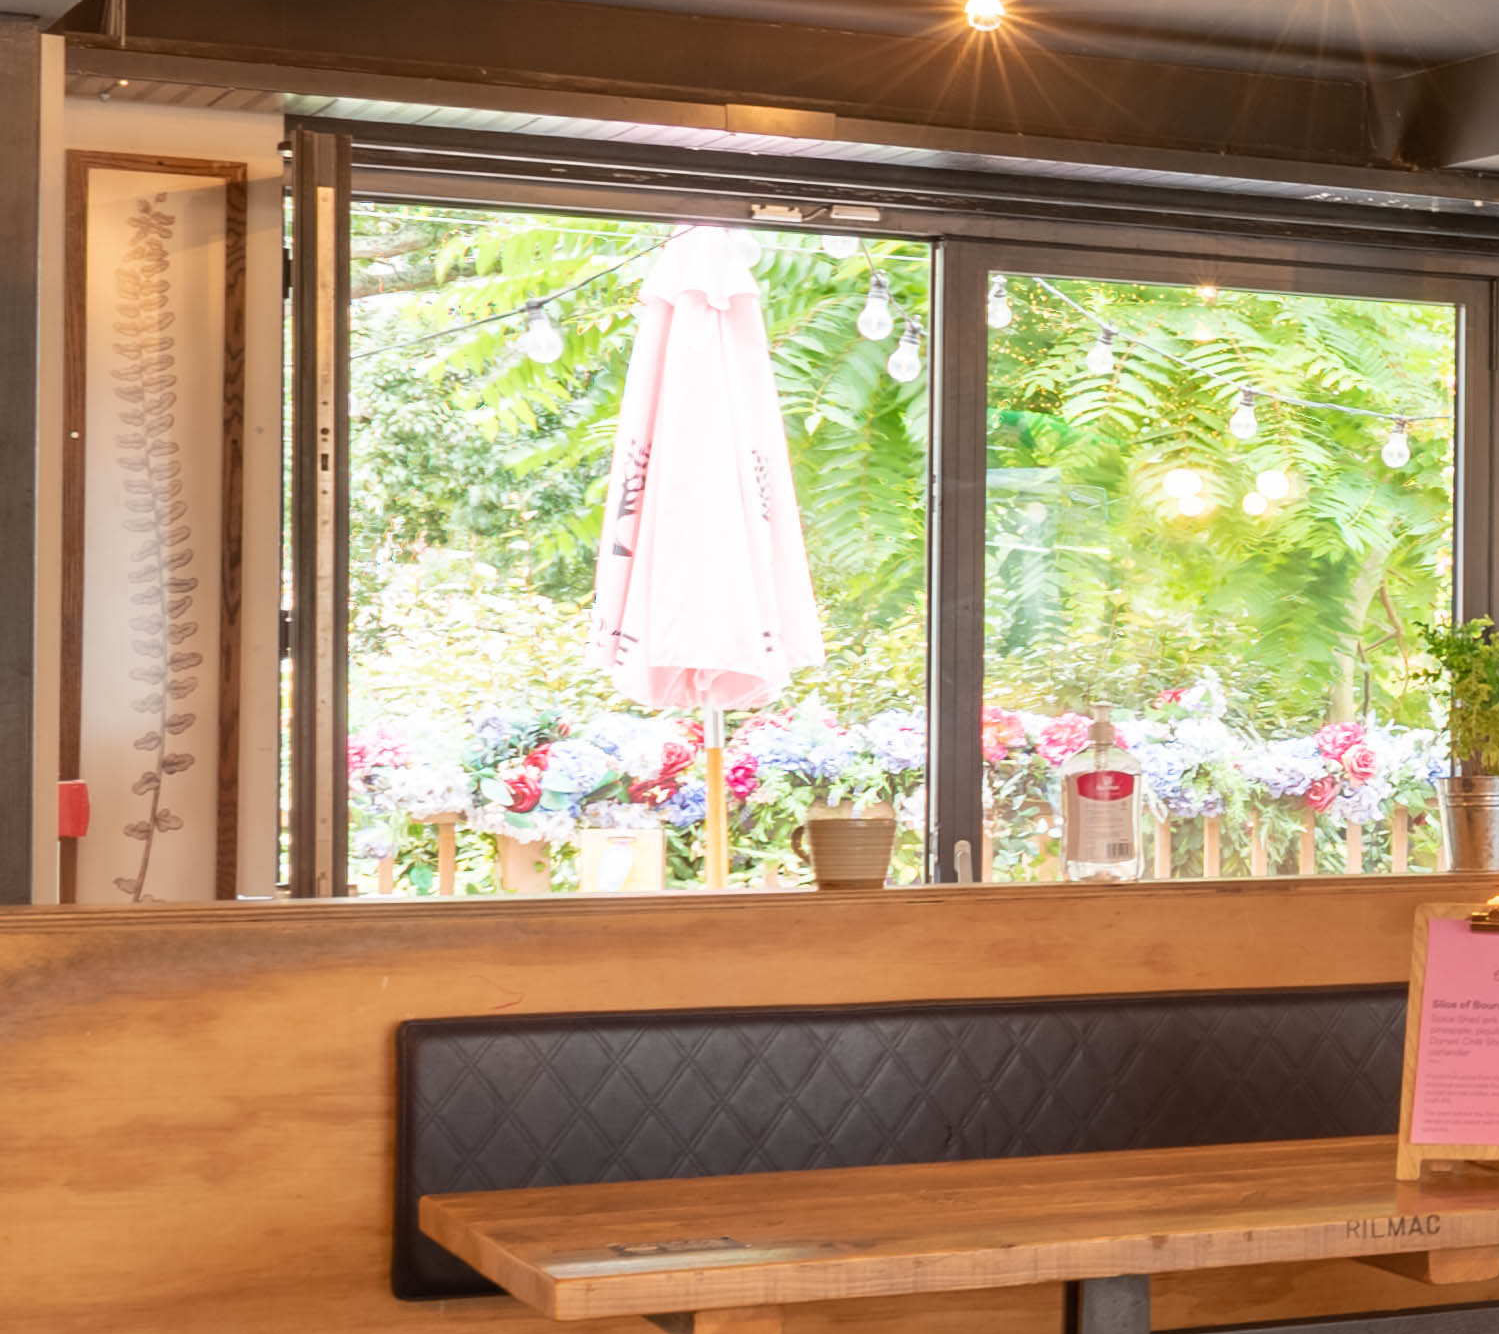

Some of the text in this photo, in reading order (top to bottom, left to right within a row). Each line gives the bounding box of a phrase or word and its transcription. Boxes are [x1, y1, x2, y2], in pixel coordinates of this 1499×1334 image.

[1432, 999, 1457, 1009] Slice
[1460, 999, 1471, 1010] of
[1345, 1214, 1441, 1239] RILMAC
